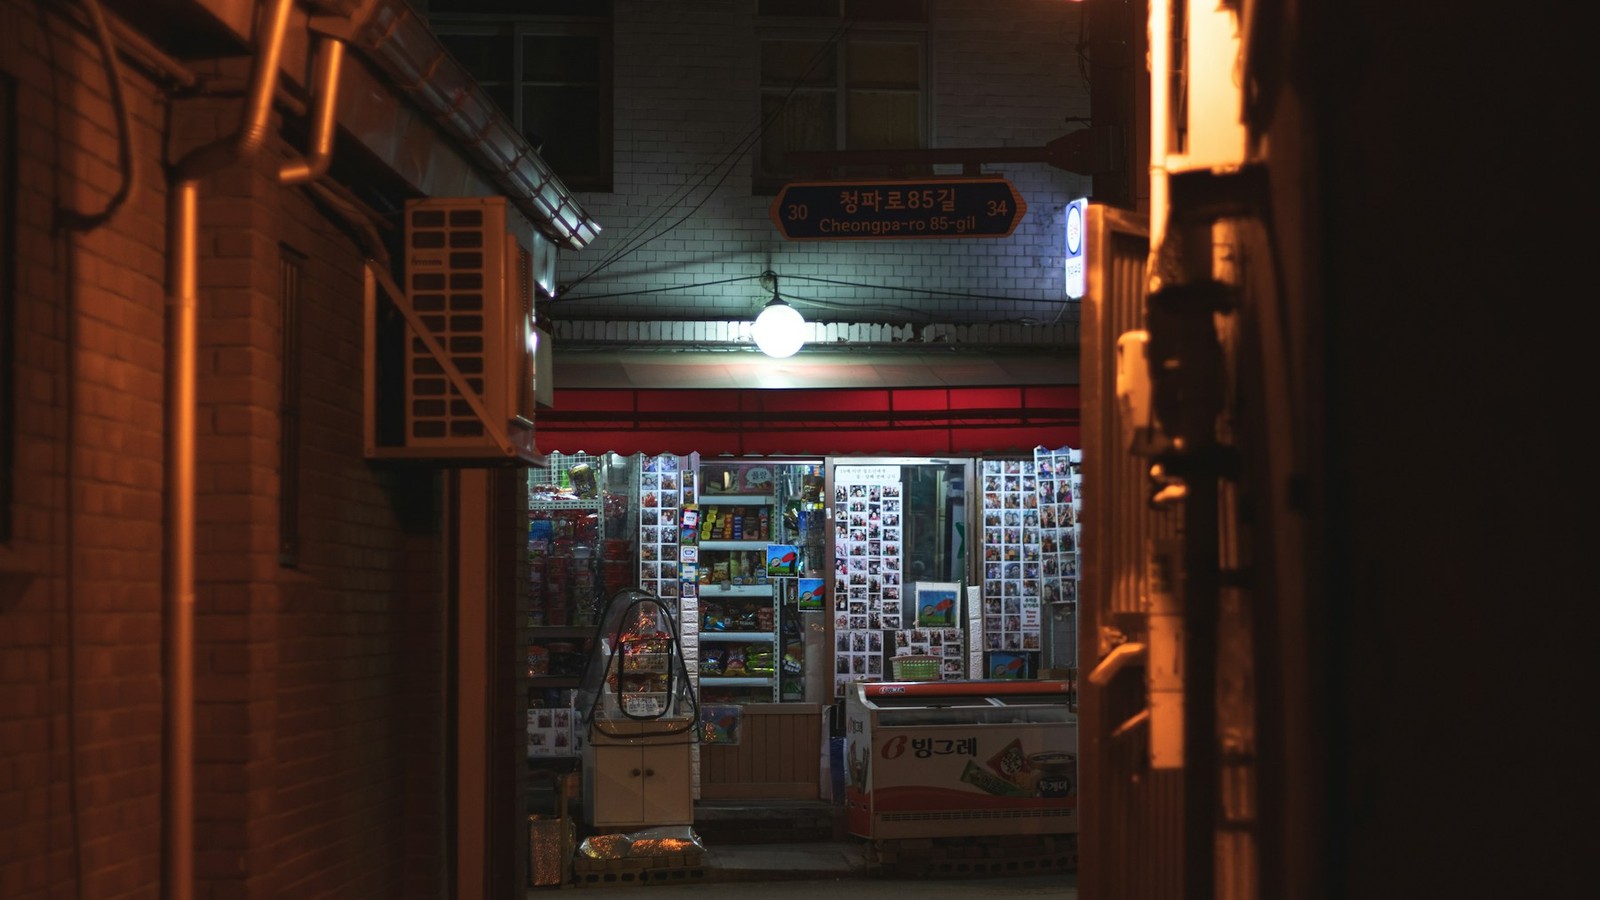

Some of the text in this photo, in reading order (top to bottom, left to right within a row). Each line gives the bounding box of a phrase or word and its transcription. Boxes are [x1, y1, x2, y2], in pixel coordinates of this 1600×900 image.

[840, 188, 956, 213] 청파로85길
[987, 200, 1008, 217] 34
[788, 204, 808, 220] 30
[819, 216, 976, 234] Cheongpa-ro 85-gil
[911, 737, 977, 759] 빙그레
